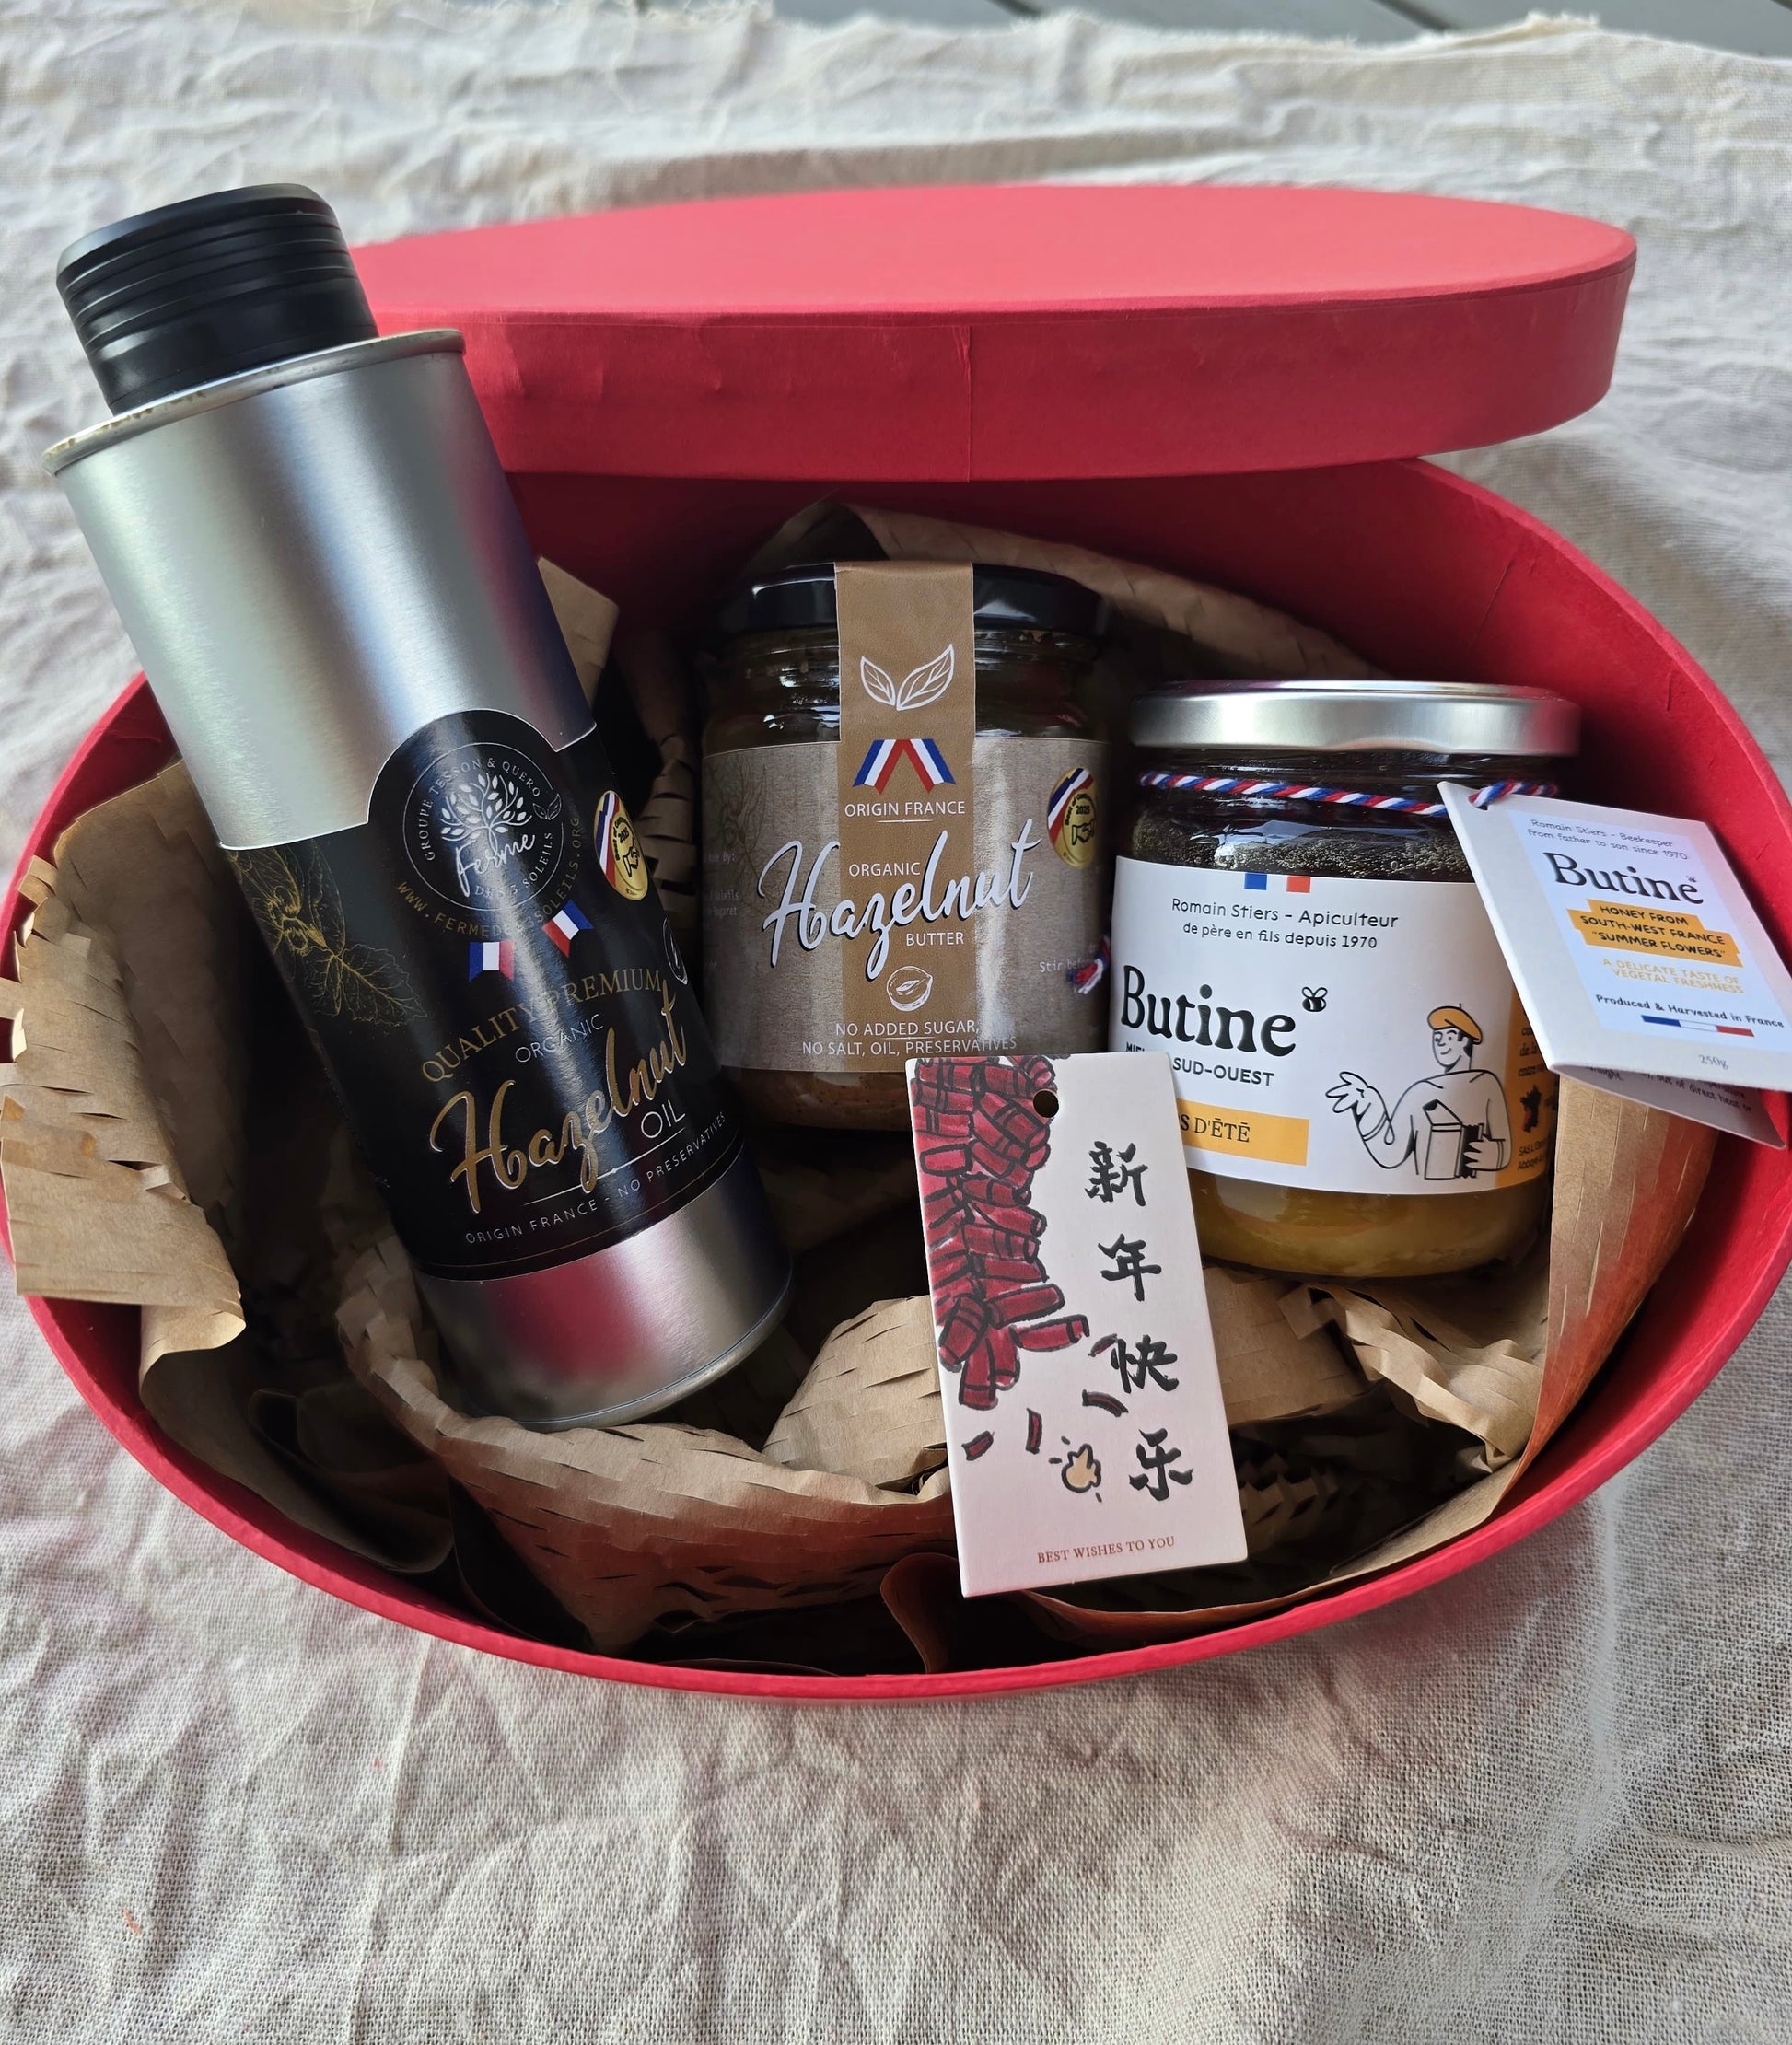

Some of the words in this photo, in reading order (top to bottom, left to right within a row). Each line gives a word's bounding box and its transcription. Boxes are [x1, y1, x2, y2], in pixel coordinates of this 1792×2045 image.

[417, 798, 436, 862] GROUPE
[428, 759, 480, 797] TESSON
[487, 757, 495, 769] &
[502, 761, 541, 798] QUERO
[844, 803, 899, 817] ORIGIN
[905, 801, 965, 815] FRANCE
[1530, 819, 1572, 832] Romain
[1575, 825, 1607, 838] Stiers
[1619, 832, 1673, 848] Beekeeper
[1557, 833, 1591, 846] father
[1610, 842, 1628, 851] son
[1633, 845, 1659, 855] since
[1662, 849, 1688, 860] 1970
[456, 834, 536, 899] Ferme
[522, 832, 553, 889] SOLEILS
[848, 862, 921, 877] ORGANIC
[1542, 852, 1704, 905] Butine
[757, 819, 1042, 981] Hazelnut
[1172, 898, 1226, 916] Romain
[1231, 904, 1278, 921] Stiers
[1298, 910, 1399, 927] Apiculteur
[1580, 915, 1666, 935] SOUTH-WEST
[1670, 928, 1726, 945] FRANCE
[1600, 905, 1646, 919] HONEY
[1649, 912, 1689, 926] FROM
[905, 932, 965, 947] BUTTER
[1183, 922, 1198, 934] de
[1202, 924, 1232, 938] père
[1236, 930, 1252, 940] en
[1258, 929, 1280, 943] fils
[1285, 932, 1337, 948] depuis
[1342, 935, 1378, 948] 1970
[1039, 960, 1062, 973] Stir
[1616, 959, 1676, 976] DELICATE
[1681, 970, 1721, 982] TASTE
[1725, 976, 1740, 984] OF
[1612, 969, 1670, 983] VEGETAL
[1674, 977, 1744, 994] FRESHNESS
[422, 999, 541, 1083] QUALITY
[551, 968, 663, 1007] PREMIUM
[1121, 965, 1296, 1057] Butine
[1596, 994, 1651, 1009] Produced
[1655, 1003, 1665, 1011] &
[1667, 1005, 1728, 1020] Harvested
[1730, 1012, 1742, 1022] in
[1745, 1015, 1785, 1028] France
[515, 1014, 604, 1063] ORGANIC
[835, 1023, 859, 1037] NO
[864, 1022, 919, 1036] ADDED
[924, 1020, 980, 1036] SUGAR,
[802, 1041, 823, 1055] NO
[828, 1041, 866, 1057] SALT,
[870, 1041, 901, 1056] OIL,
[905, 1036, 1017, 1055] PRESERVATIVES
[1172, 1057, 1274, 1086] SUD-OUEST
[429, 979, 687, 1214] Hazelnut
[641, 1100, 686, 1139] OIL
[465, 1223, 523, 1244] ORIGIN
[529, 1200, 598, 1232] FRANCE
[617, 1179, 641, 1196] NO
[646, 1111, 726, 1182] PRESERVATIVES
[1084, 1141, 1193, 1501] 新年快乐
[1038, 1550, 1069, 1563] BEST
[1073, 1543, 1123, 1558] WISHES
[1126, 1540, 1145, 1551] TO
[1147, 1536, 1175, 1549] YOU
